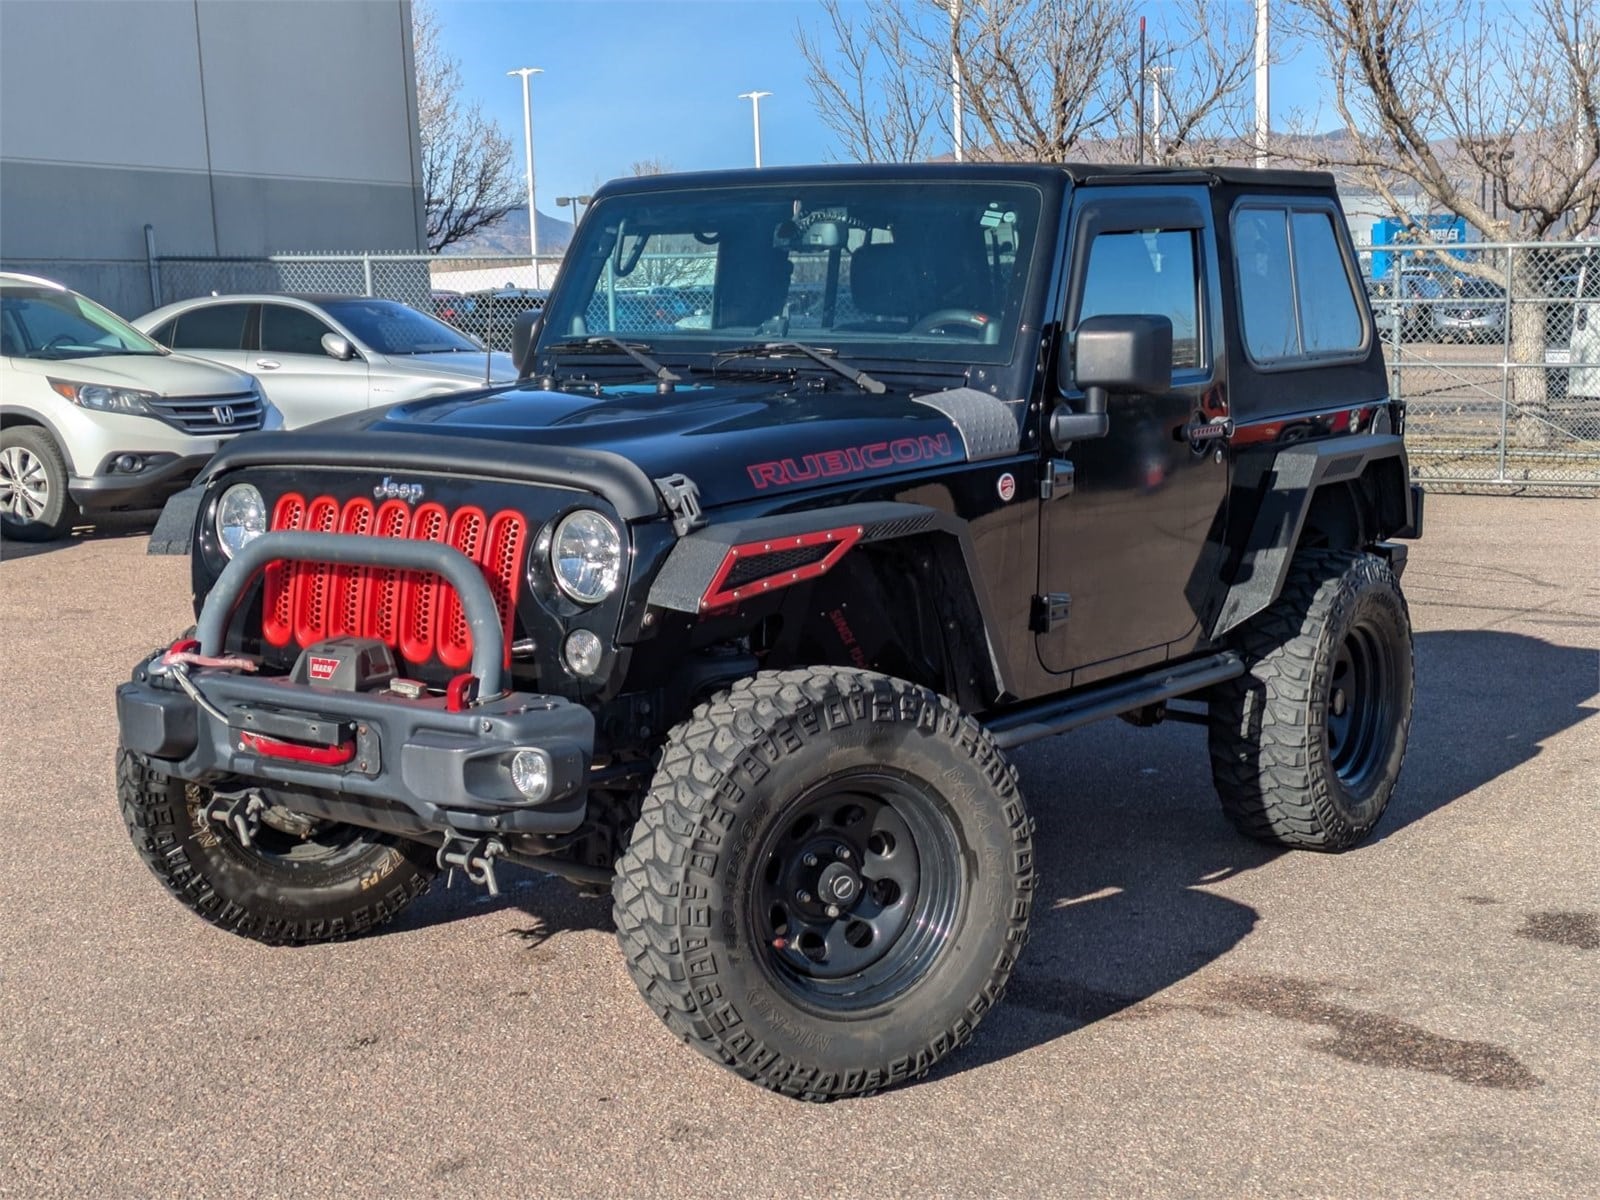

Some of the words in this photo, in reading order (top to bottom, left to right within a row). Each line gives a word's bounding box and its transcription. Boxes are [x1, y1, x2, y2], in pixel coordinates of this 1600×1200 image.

[747, 433, 952, 489] RUBICON
[373, 475, 424, 504] Jeep
[312, 663, 333, 673] WARN
